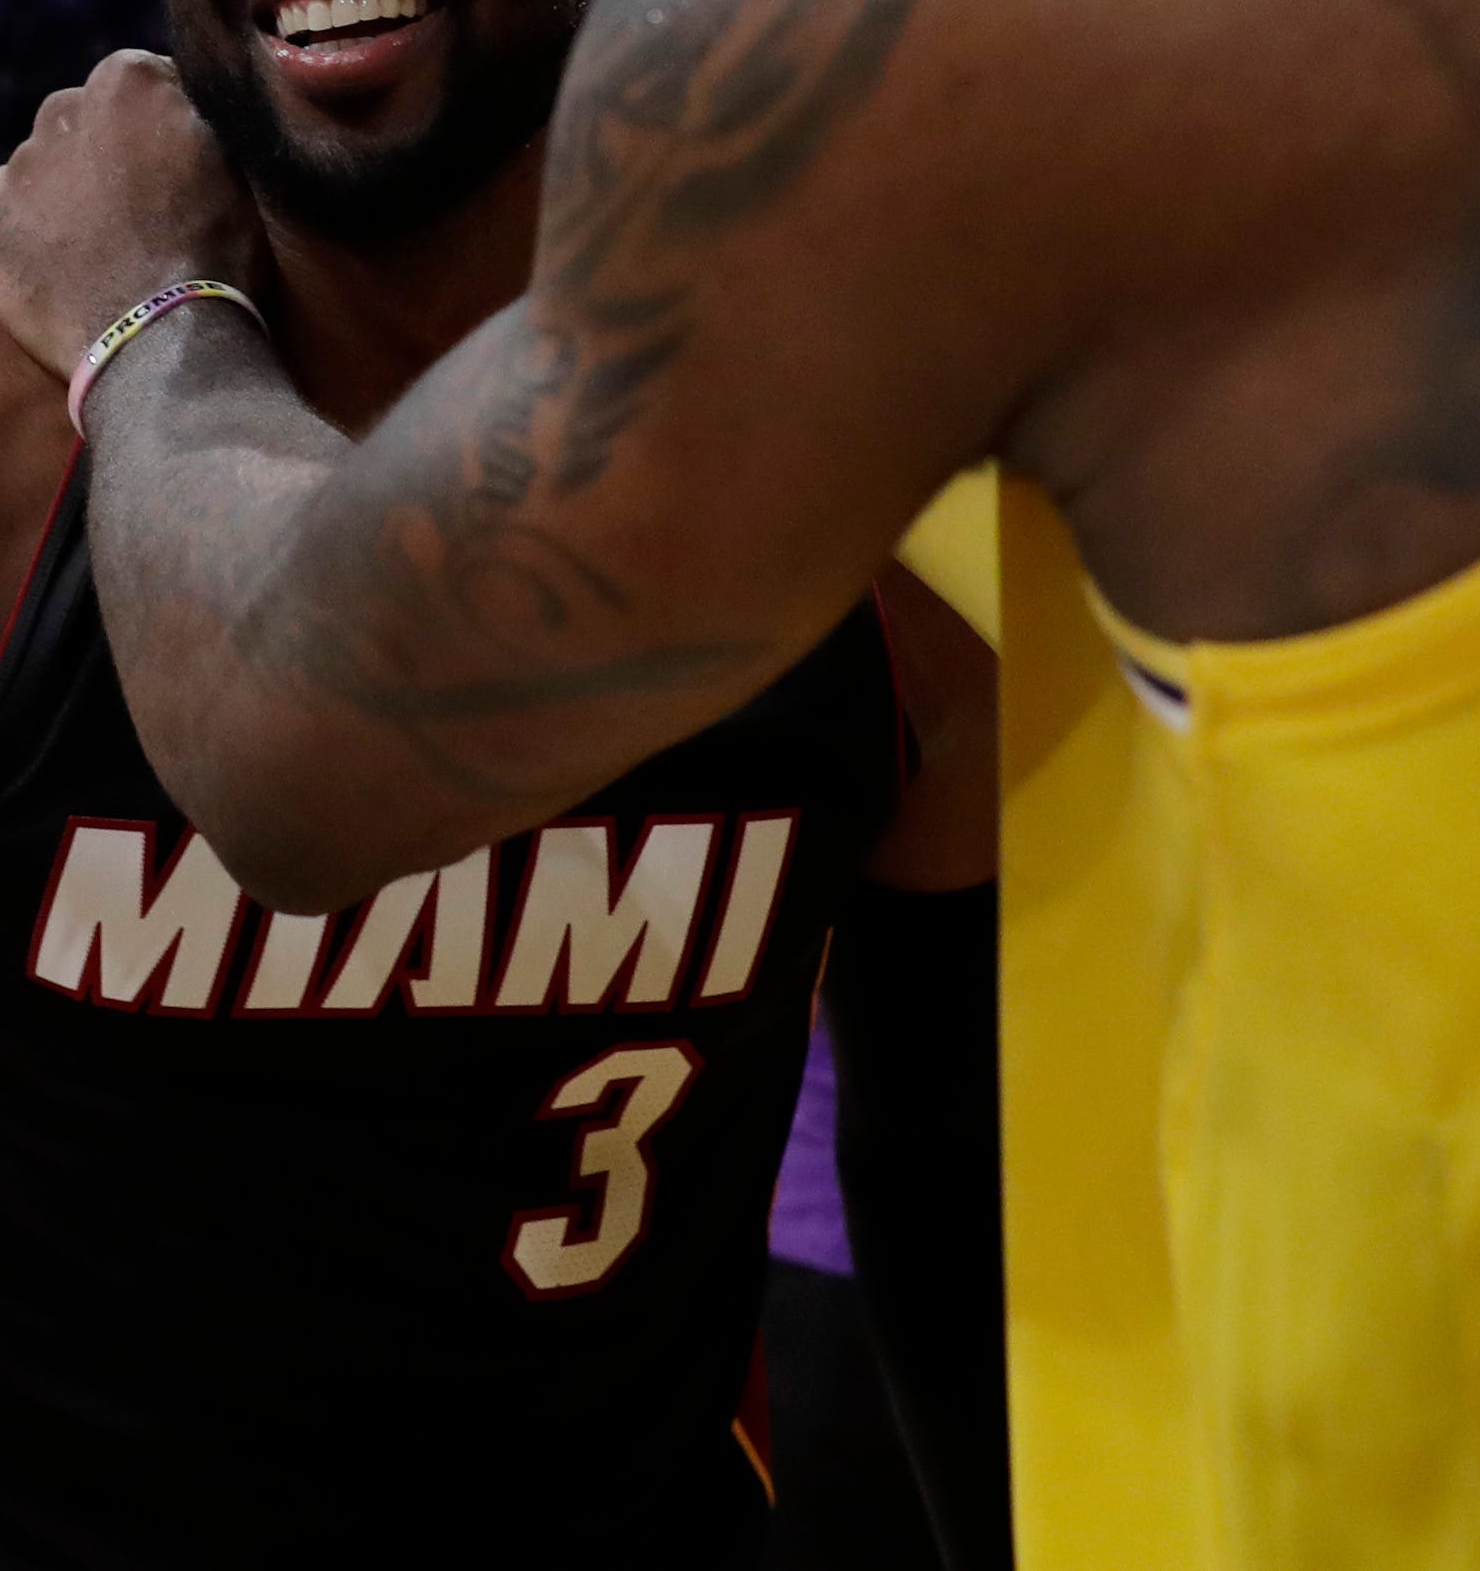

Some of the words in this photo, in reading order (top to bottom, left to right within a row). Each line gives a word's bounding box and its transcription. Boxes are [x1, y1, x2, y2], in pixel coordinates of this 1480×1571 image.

[100, 281, 228, 349] PROMISE
[27, 809, 802, 1019] MIAMI
[500, 1038, 706, 1302] 3
